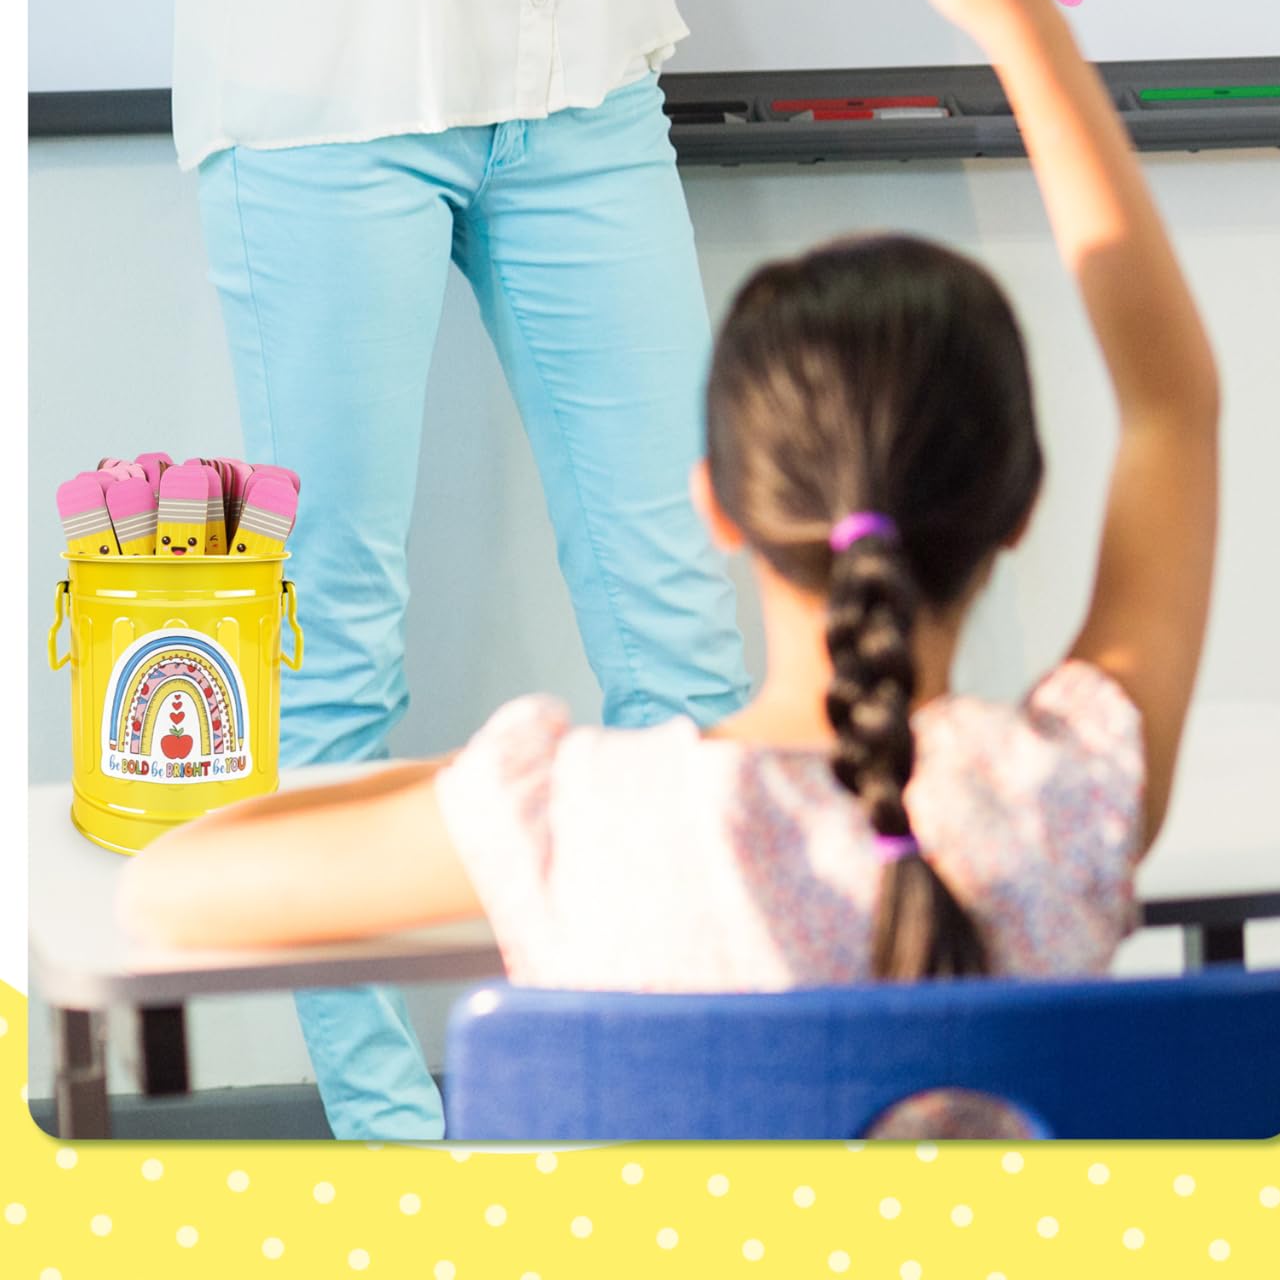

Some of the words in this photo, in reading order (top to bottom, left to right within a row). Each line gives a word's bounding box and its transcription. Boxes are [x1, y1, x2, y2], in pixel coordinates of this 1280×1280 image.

[109, 754, 121, 771] be
[121, 758, 149, 776] BOLD
[151, 761, 164, 777] be
[165, 761, 211, 778] BRIGHT
[212, 757, 225, 775] be
[225, 756, 246, 773] YOU
